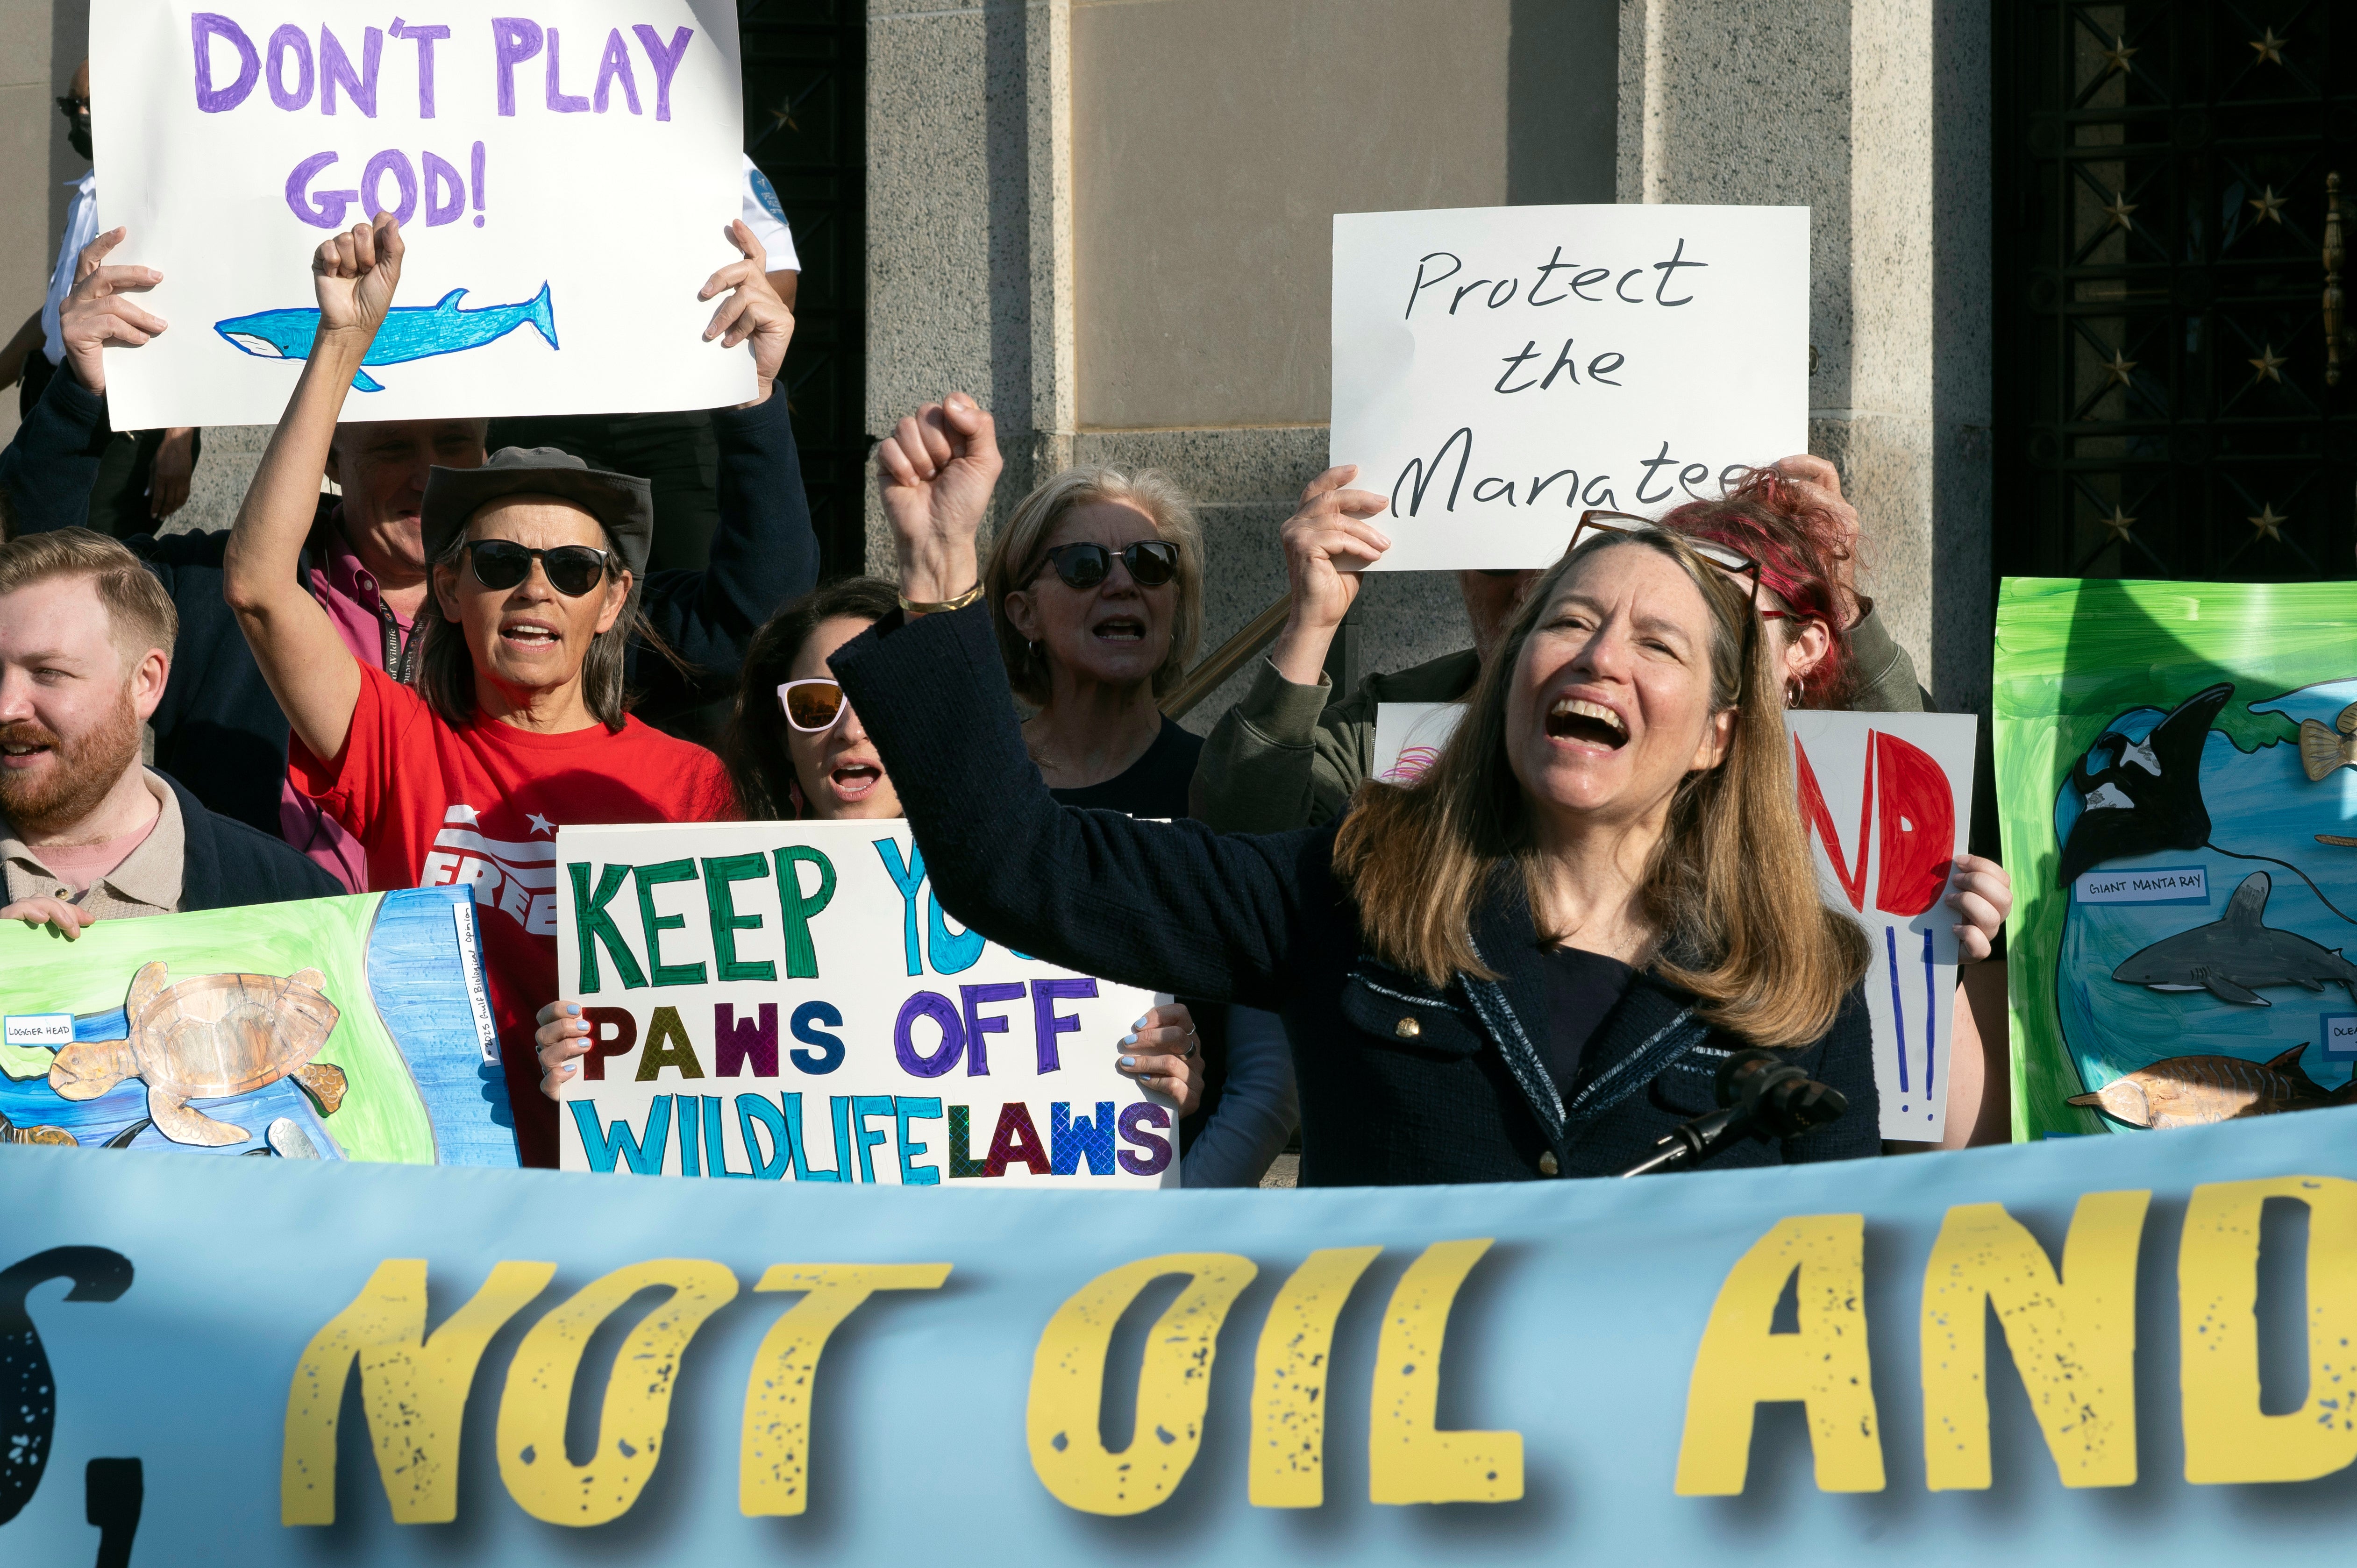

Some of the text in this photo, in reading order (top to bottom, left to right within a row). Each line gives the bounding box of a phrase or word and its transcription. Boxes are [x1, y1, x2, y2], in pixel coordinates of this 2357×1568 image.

[191, 12, 694, 121] DON'T PLAY
[285, 141, 486, 229] GOD!
[1405, 237, 1709, 319] Protect
[1494, 338, 1625, 394] the
[1391, 427, 1755, 518] Manatee
[389, 668, 397, 681] of
[419, 850, 557, 937] FREE
[566, 844, 837, 995] KEEP
[2089, 873, 2201, 894] GIANT MANTA RAY
[468, 950, 483, 993] Biological
[476, 997, 488, 1019] Gulf
[8, 1026, 70, 1036] LOGGER HEAD
[581, 977, 1099, 1082] PAWS OFF
[2334, 1027, 2357, 1037] OCE
[566, 1090, 1173, 1185] WILDLIFE LAWS
[281, 1257, 954, 1527] NOT
[1025, 1238, 1524, 1517] OIL
[1674, 1174, 2357, 1496] AND
